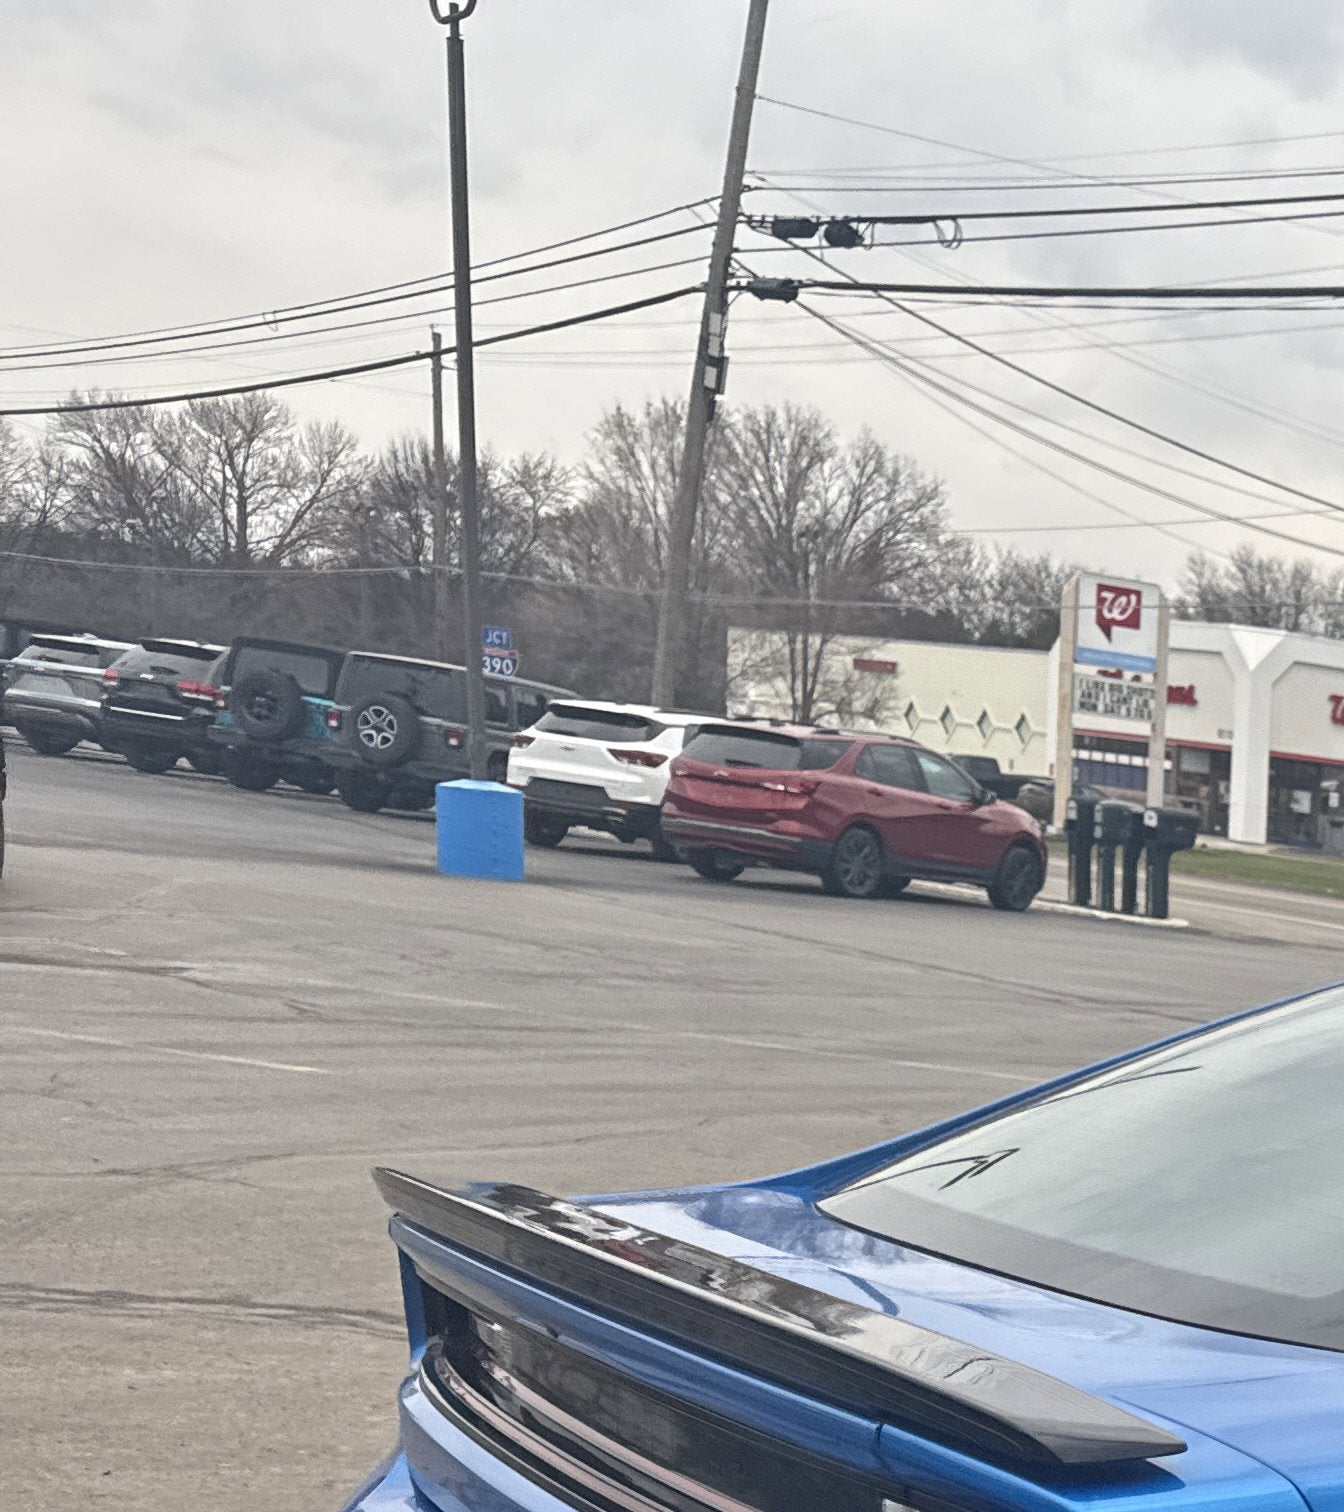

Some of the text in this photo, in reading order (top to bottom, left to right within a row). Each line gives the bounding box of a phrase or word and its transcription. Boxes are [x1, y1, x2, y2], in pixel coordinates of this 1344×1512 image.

[1100, 591, 1137, 620] W
[486, 630, 507, 645] JCT
[482, 656, 513, 675] 390
